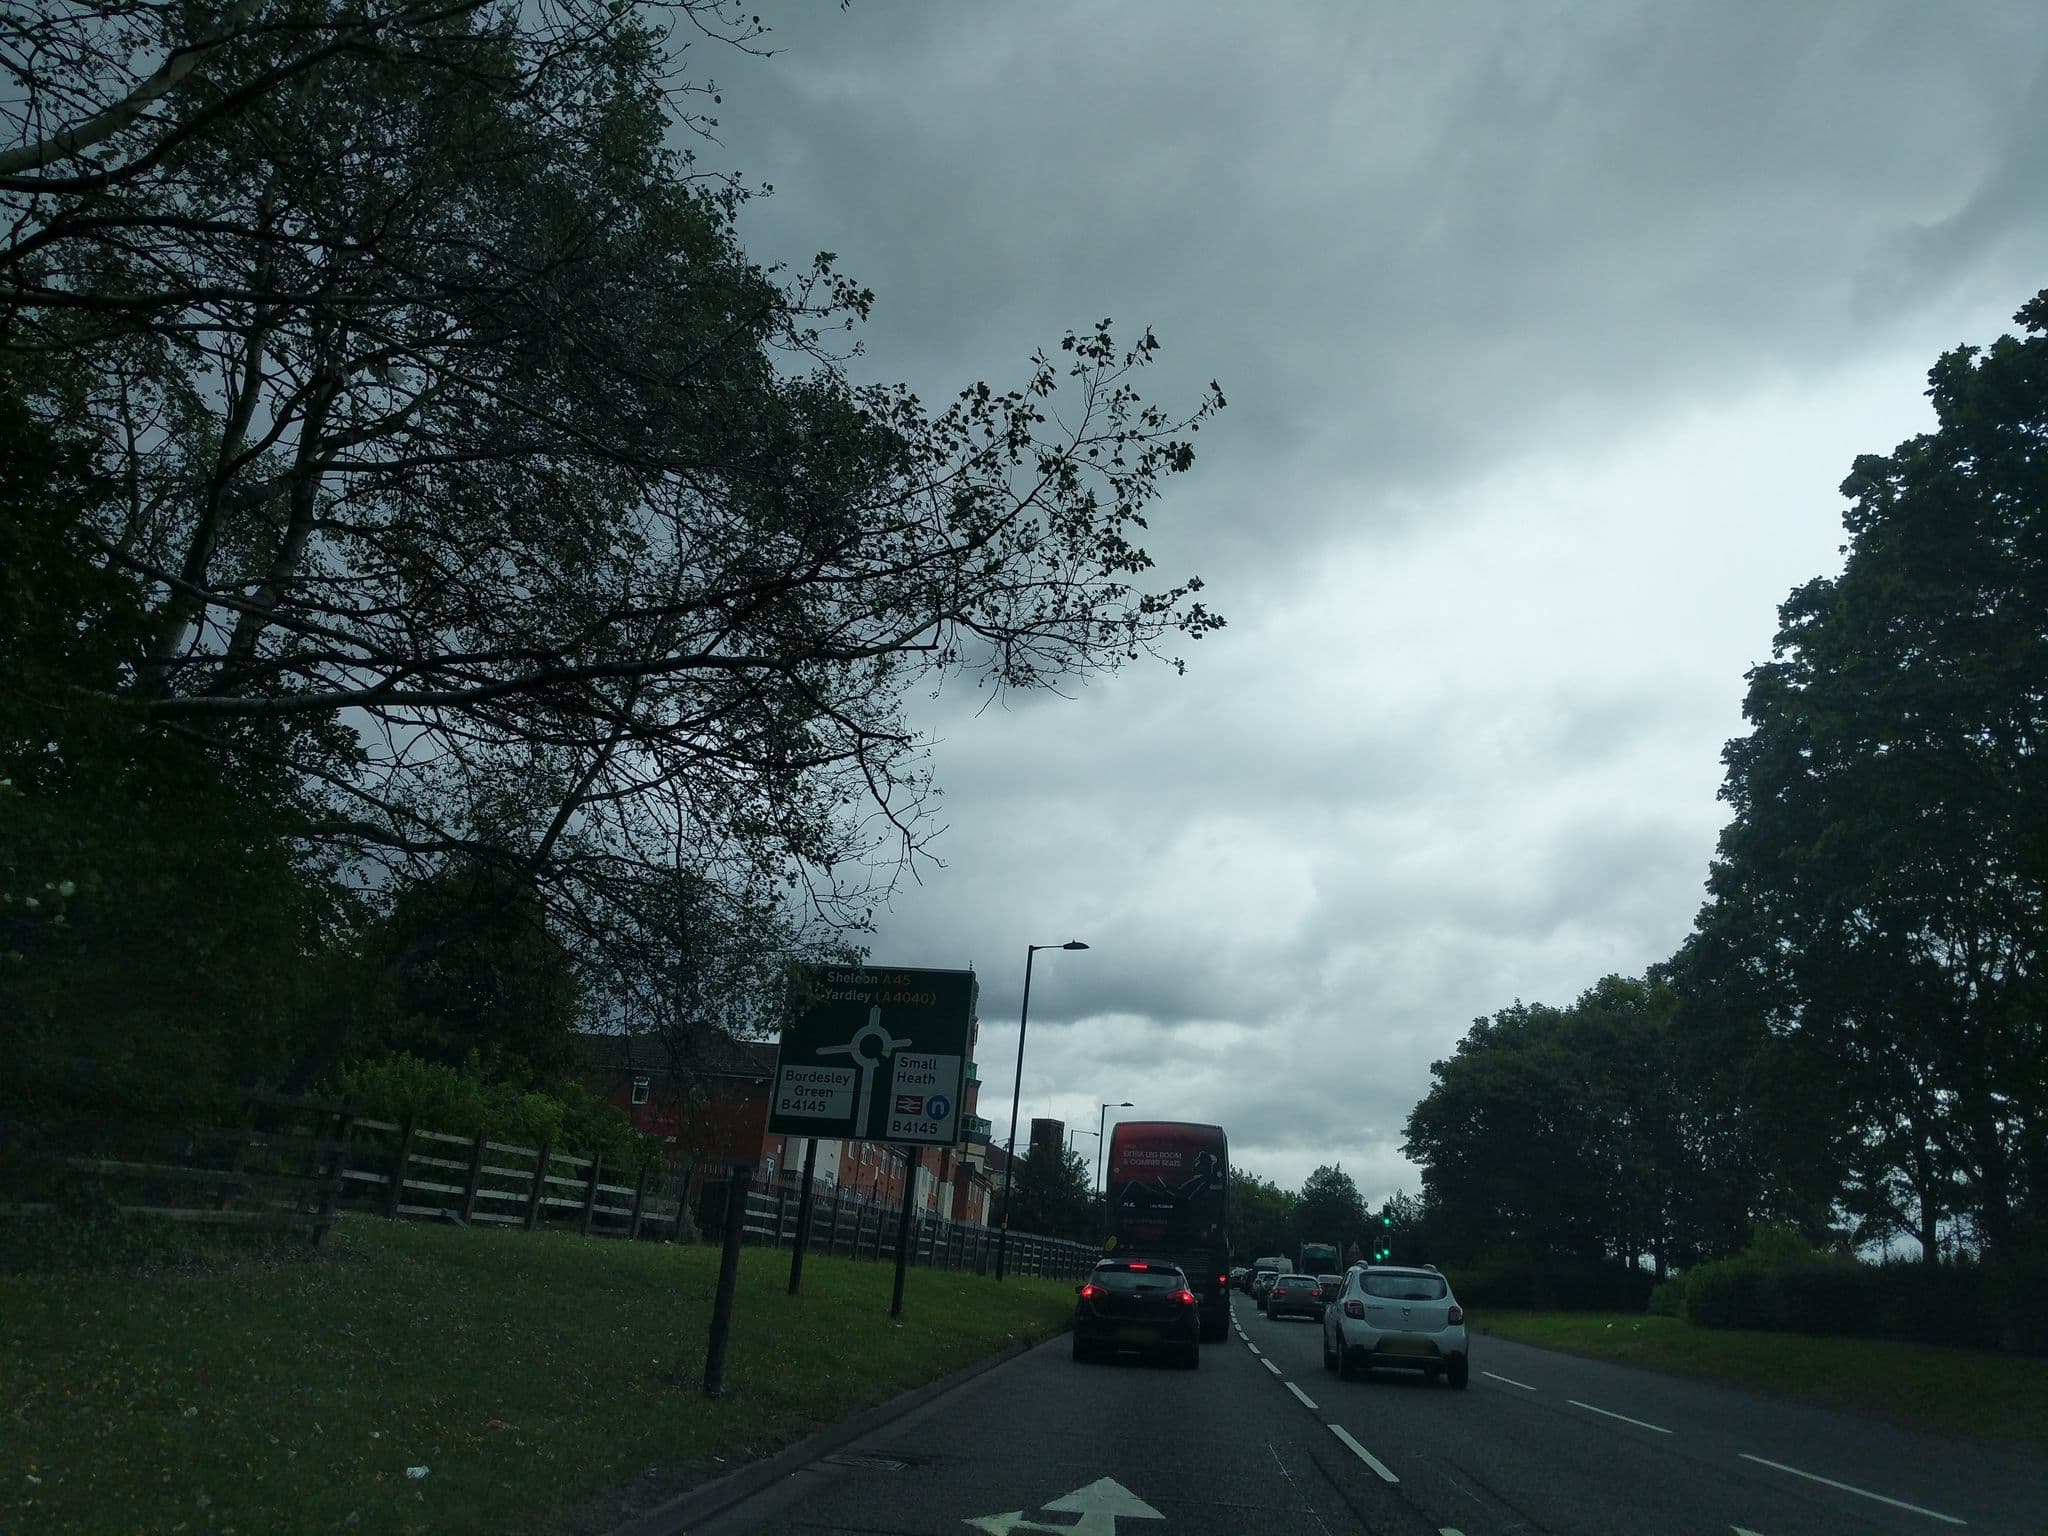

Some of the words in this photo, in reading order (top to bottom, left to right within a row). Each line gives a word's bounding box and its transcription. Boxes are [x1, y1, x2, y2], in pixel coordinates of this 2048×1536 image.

[825, 988, 872, 1003] Yardley
[900, 1057, 937, 1070] Small
[785, 1070, 850, 1086] Bordesley
[896, 1071, 936, 1085] Heath
[794, 1085, 834, 1098] Green
[782, 1099, 827, 1112] B4145
[893, 1121, 938, 1135] B4145
